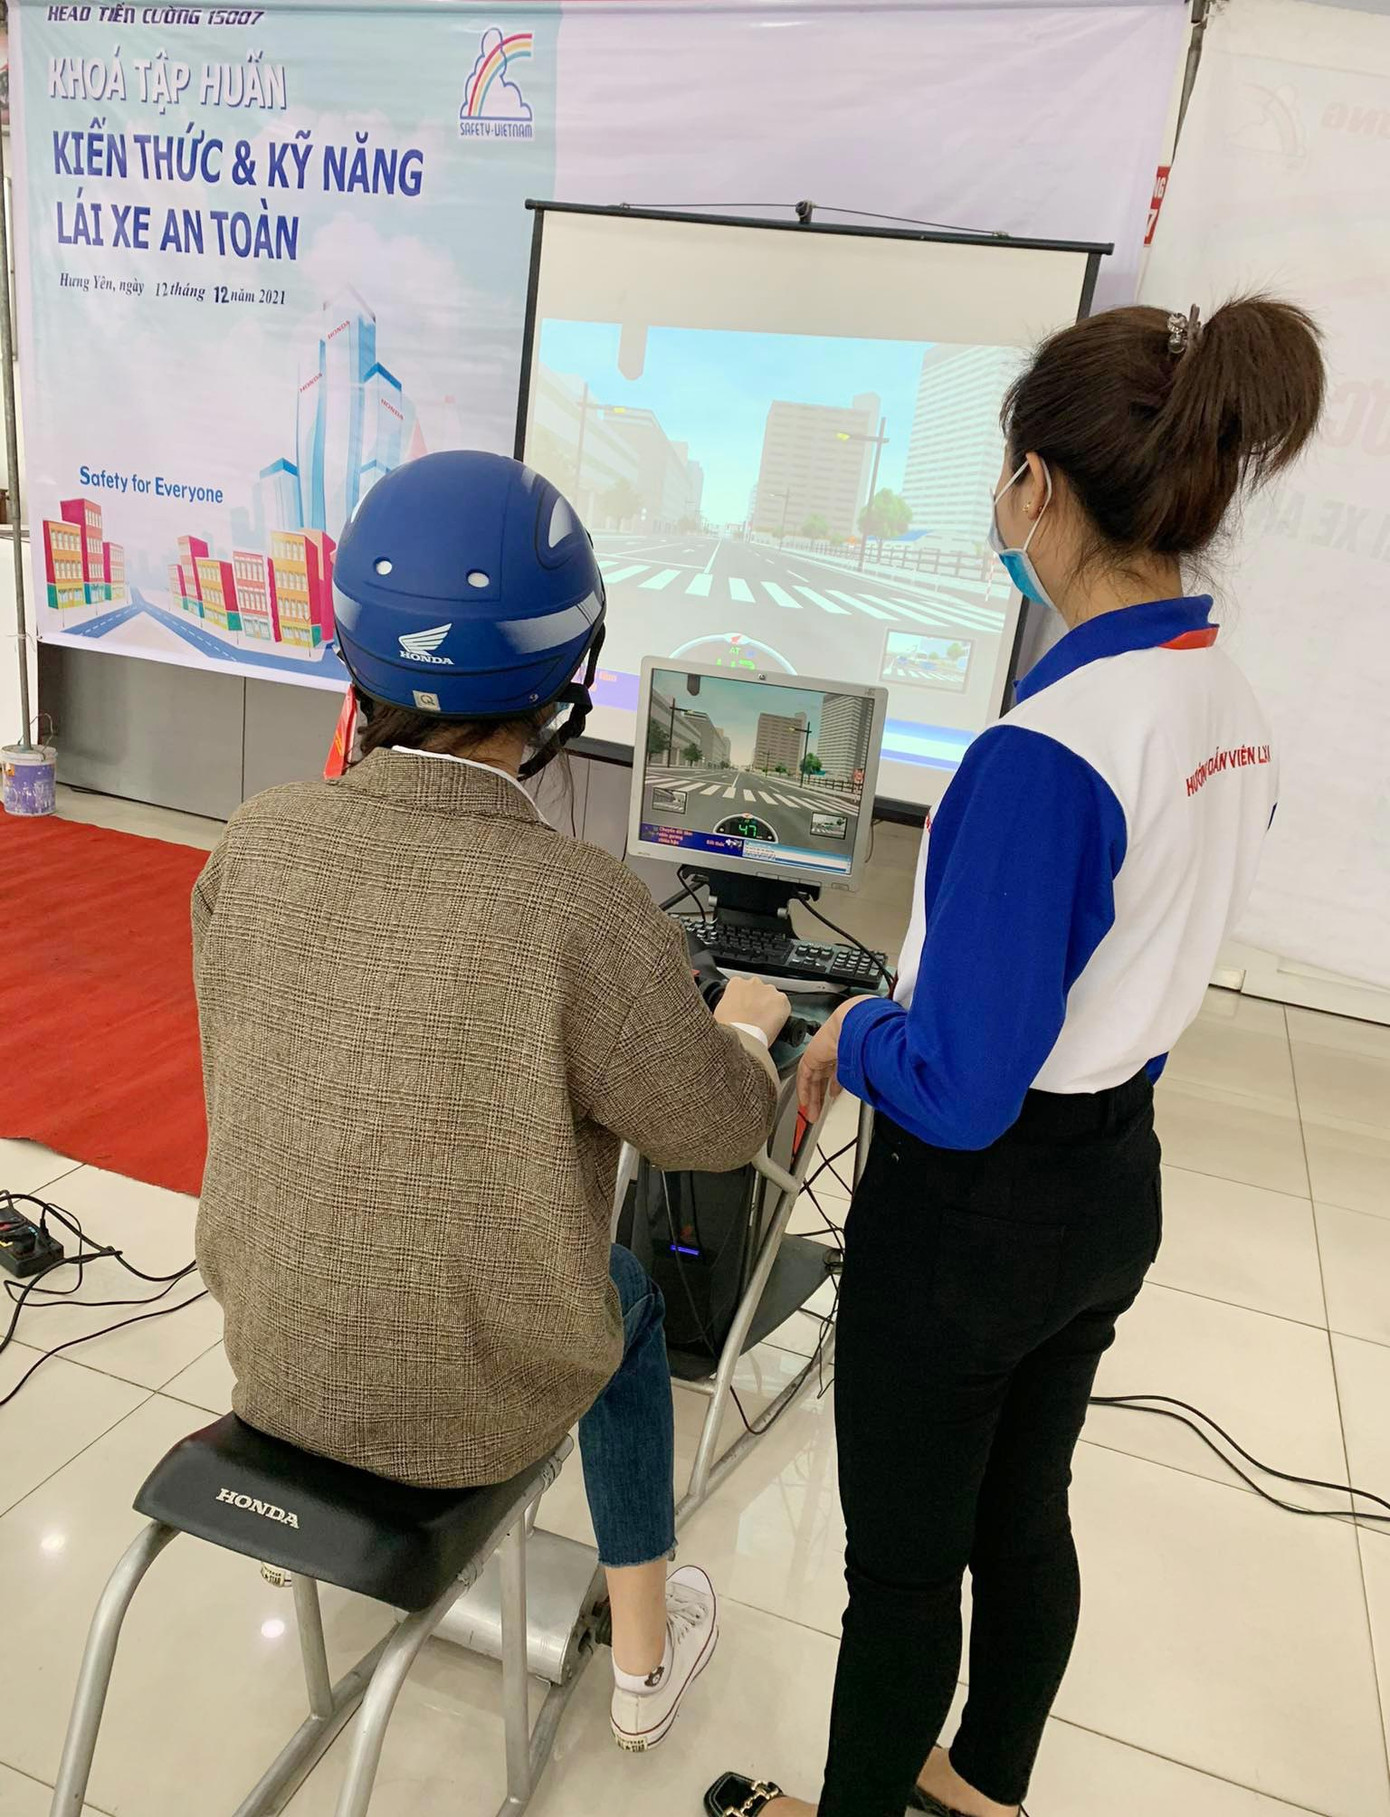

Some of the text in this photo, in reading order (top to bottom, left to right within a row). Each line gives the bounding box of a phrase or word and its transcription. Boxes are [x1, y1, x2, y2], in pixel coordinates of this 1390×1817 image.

[48, 2, 265, 26] HEAD TIẾN CƯỜNG 15007
[50, 44, 287, 115] KHOÁ TẬP HUẤN
[53, 117, 424, 197] KIẾN THỨC & KỸ NĂNG
[56, 187, 300, 261] LÁI XE AN TOÀN
[59, 272, 90, 293] Hưng
[93, 274, 116, 292] Yên,
[119, 277, 145, 297] ngày
[169, 281, 206, 302] tháng
[214, 286, 230, 304] 12
[230, 288, 255, 303] năm
[259, 288, 286, 305] 2021
[327, 320, 351, 340] HONDA
[299, 372, 323, 393] HONDA
[380, 398, 404, 421] HONDA
[79, 465, 224, 504] Safety for Everyone
[400, 650, 455, 665] HONDA
[738, 823, 758, 837] 47
[215, 1487, 300, 1529] HONDA
